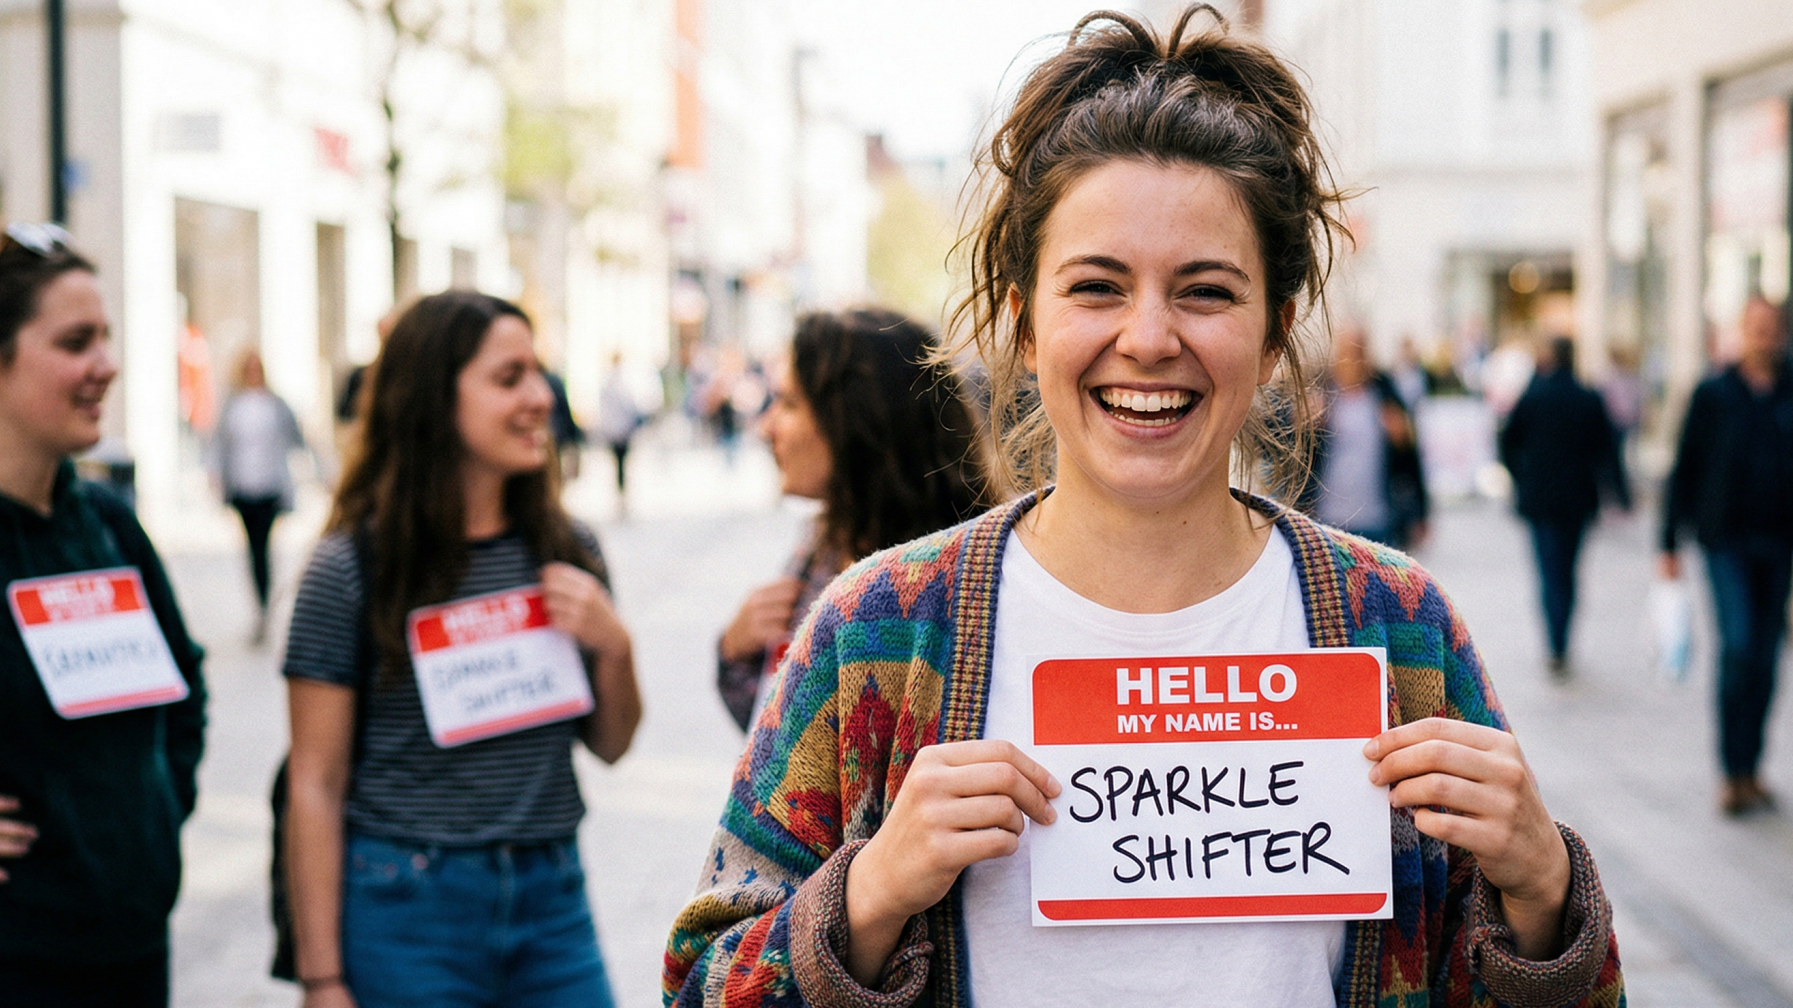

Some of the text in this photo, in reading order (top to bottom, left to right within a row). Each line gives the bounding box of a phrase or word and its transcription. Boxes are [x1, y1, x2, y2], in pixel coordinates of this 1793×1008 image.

[1116, 664, 1298, 705] HELLO
[1117, 712, 1298, 733] MY NAME IS...
[1070, 761, 1304, 823] SPARKLE
[1113, 821, 1350, 883] SHIFTER
